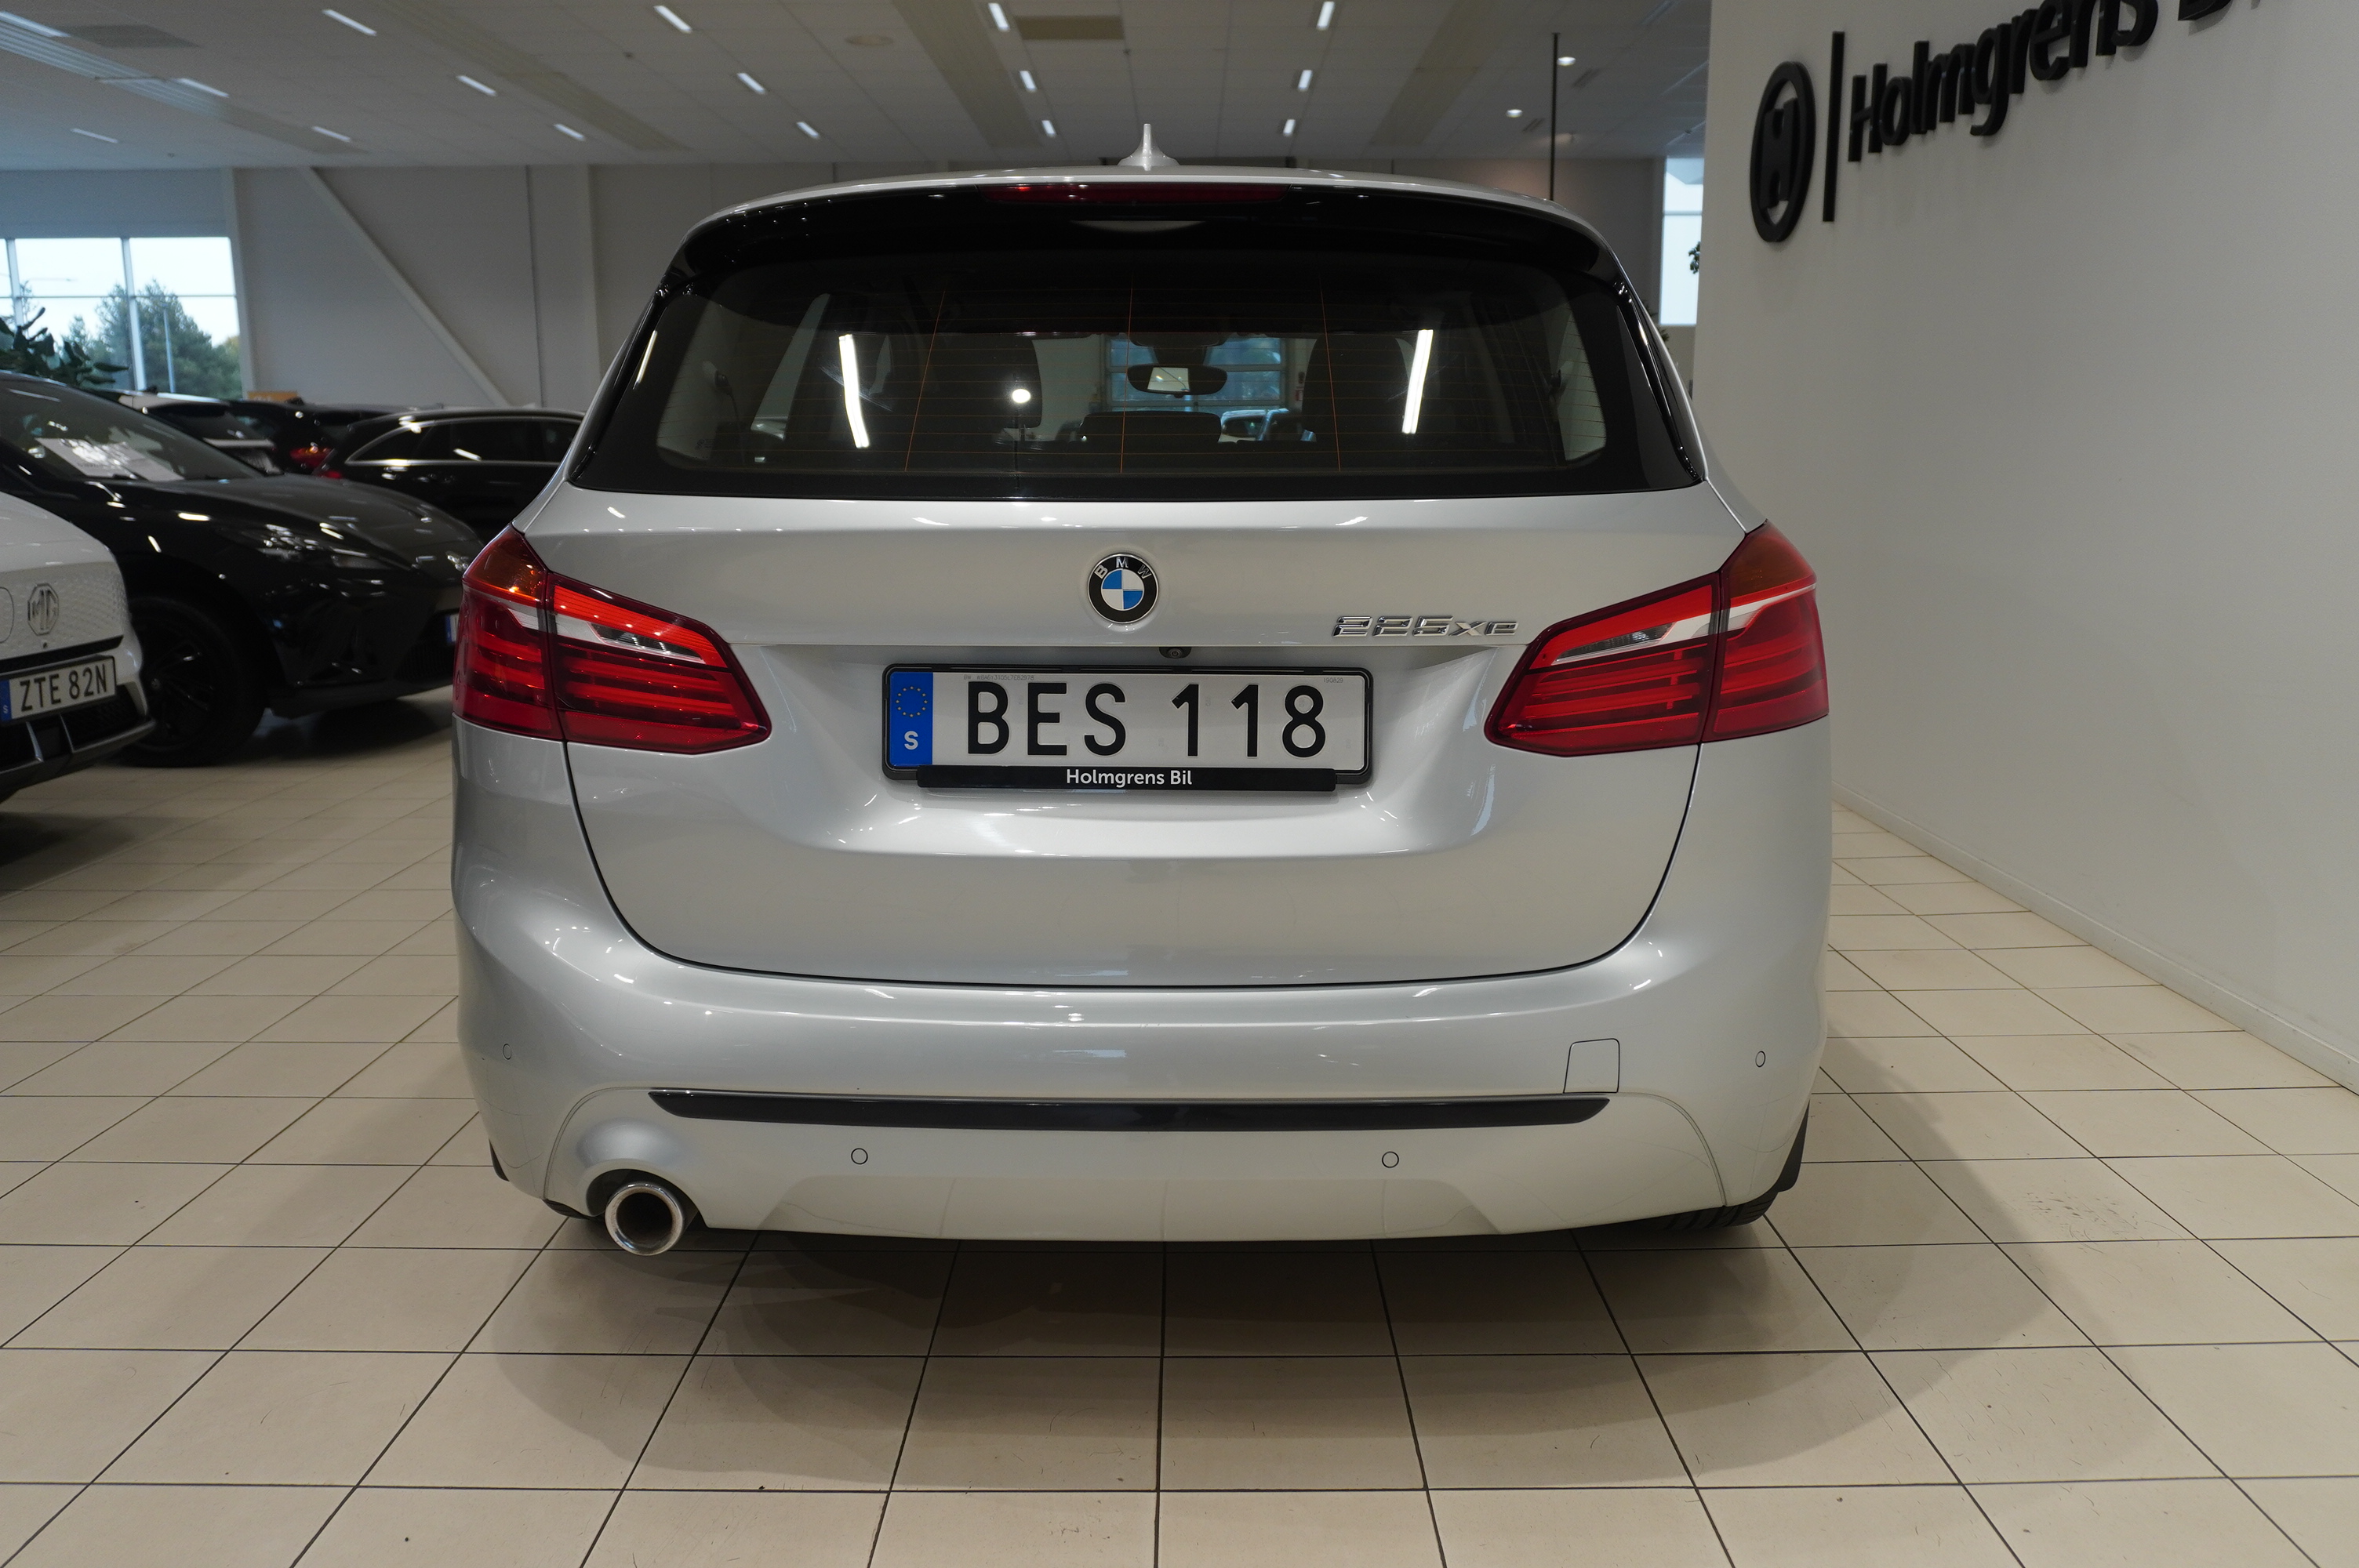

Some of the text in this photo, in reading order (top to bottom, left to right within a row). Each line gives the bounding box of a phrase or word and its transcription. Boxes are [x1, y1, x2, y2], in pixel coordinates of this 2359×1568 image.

[1094, 556, 1152, 579] BMW
[1332, 615, 1518, 637] 225xe
[20, 664, 107, 712] ZTE 82N
[968, 681, 1326, 758] BES 118
[904, 731, 918, 750] S
[1067, 769, 1192, 788] Holmgrens Bil
